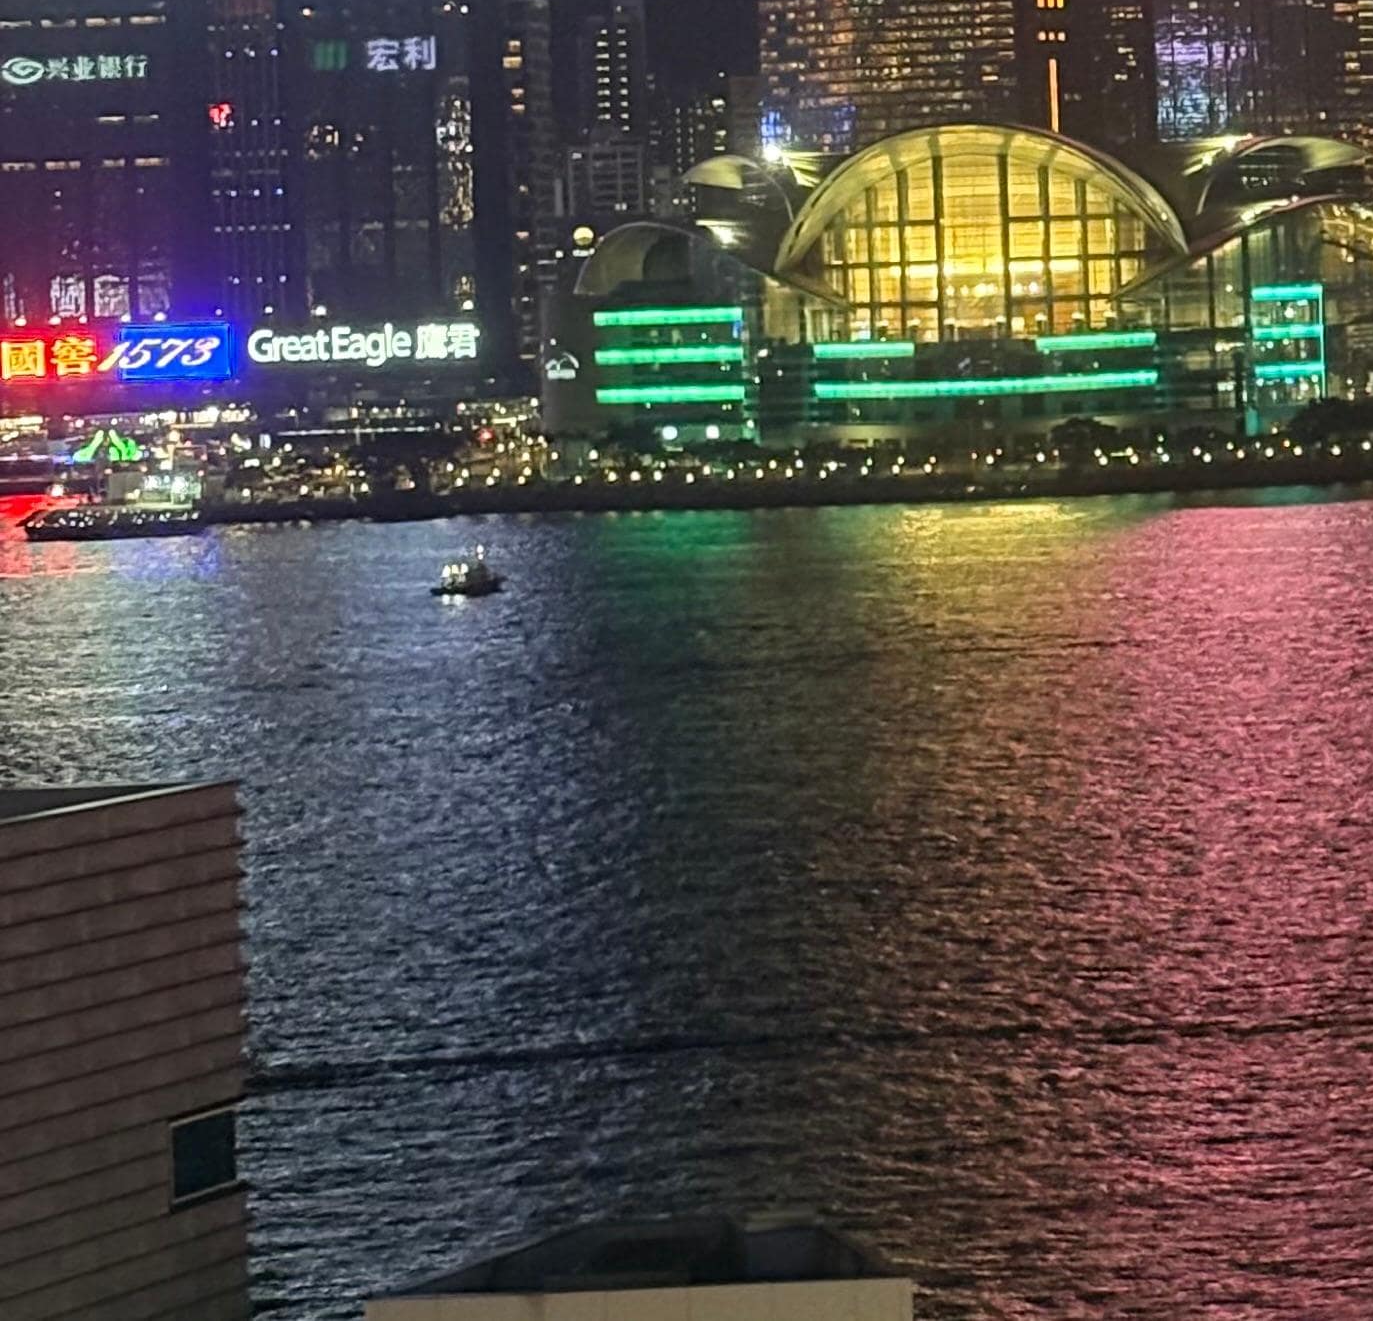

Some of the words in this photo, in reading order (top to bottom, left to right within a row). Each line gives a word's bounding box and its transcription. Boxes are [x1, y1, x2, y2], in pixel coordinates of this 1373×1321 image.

[366, 35, 437, 72] 宏利
[247, 329, 330, 362] Great
[331, 323, 412, 367] Eagle
